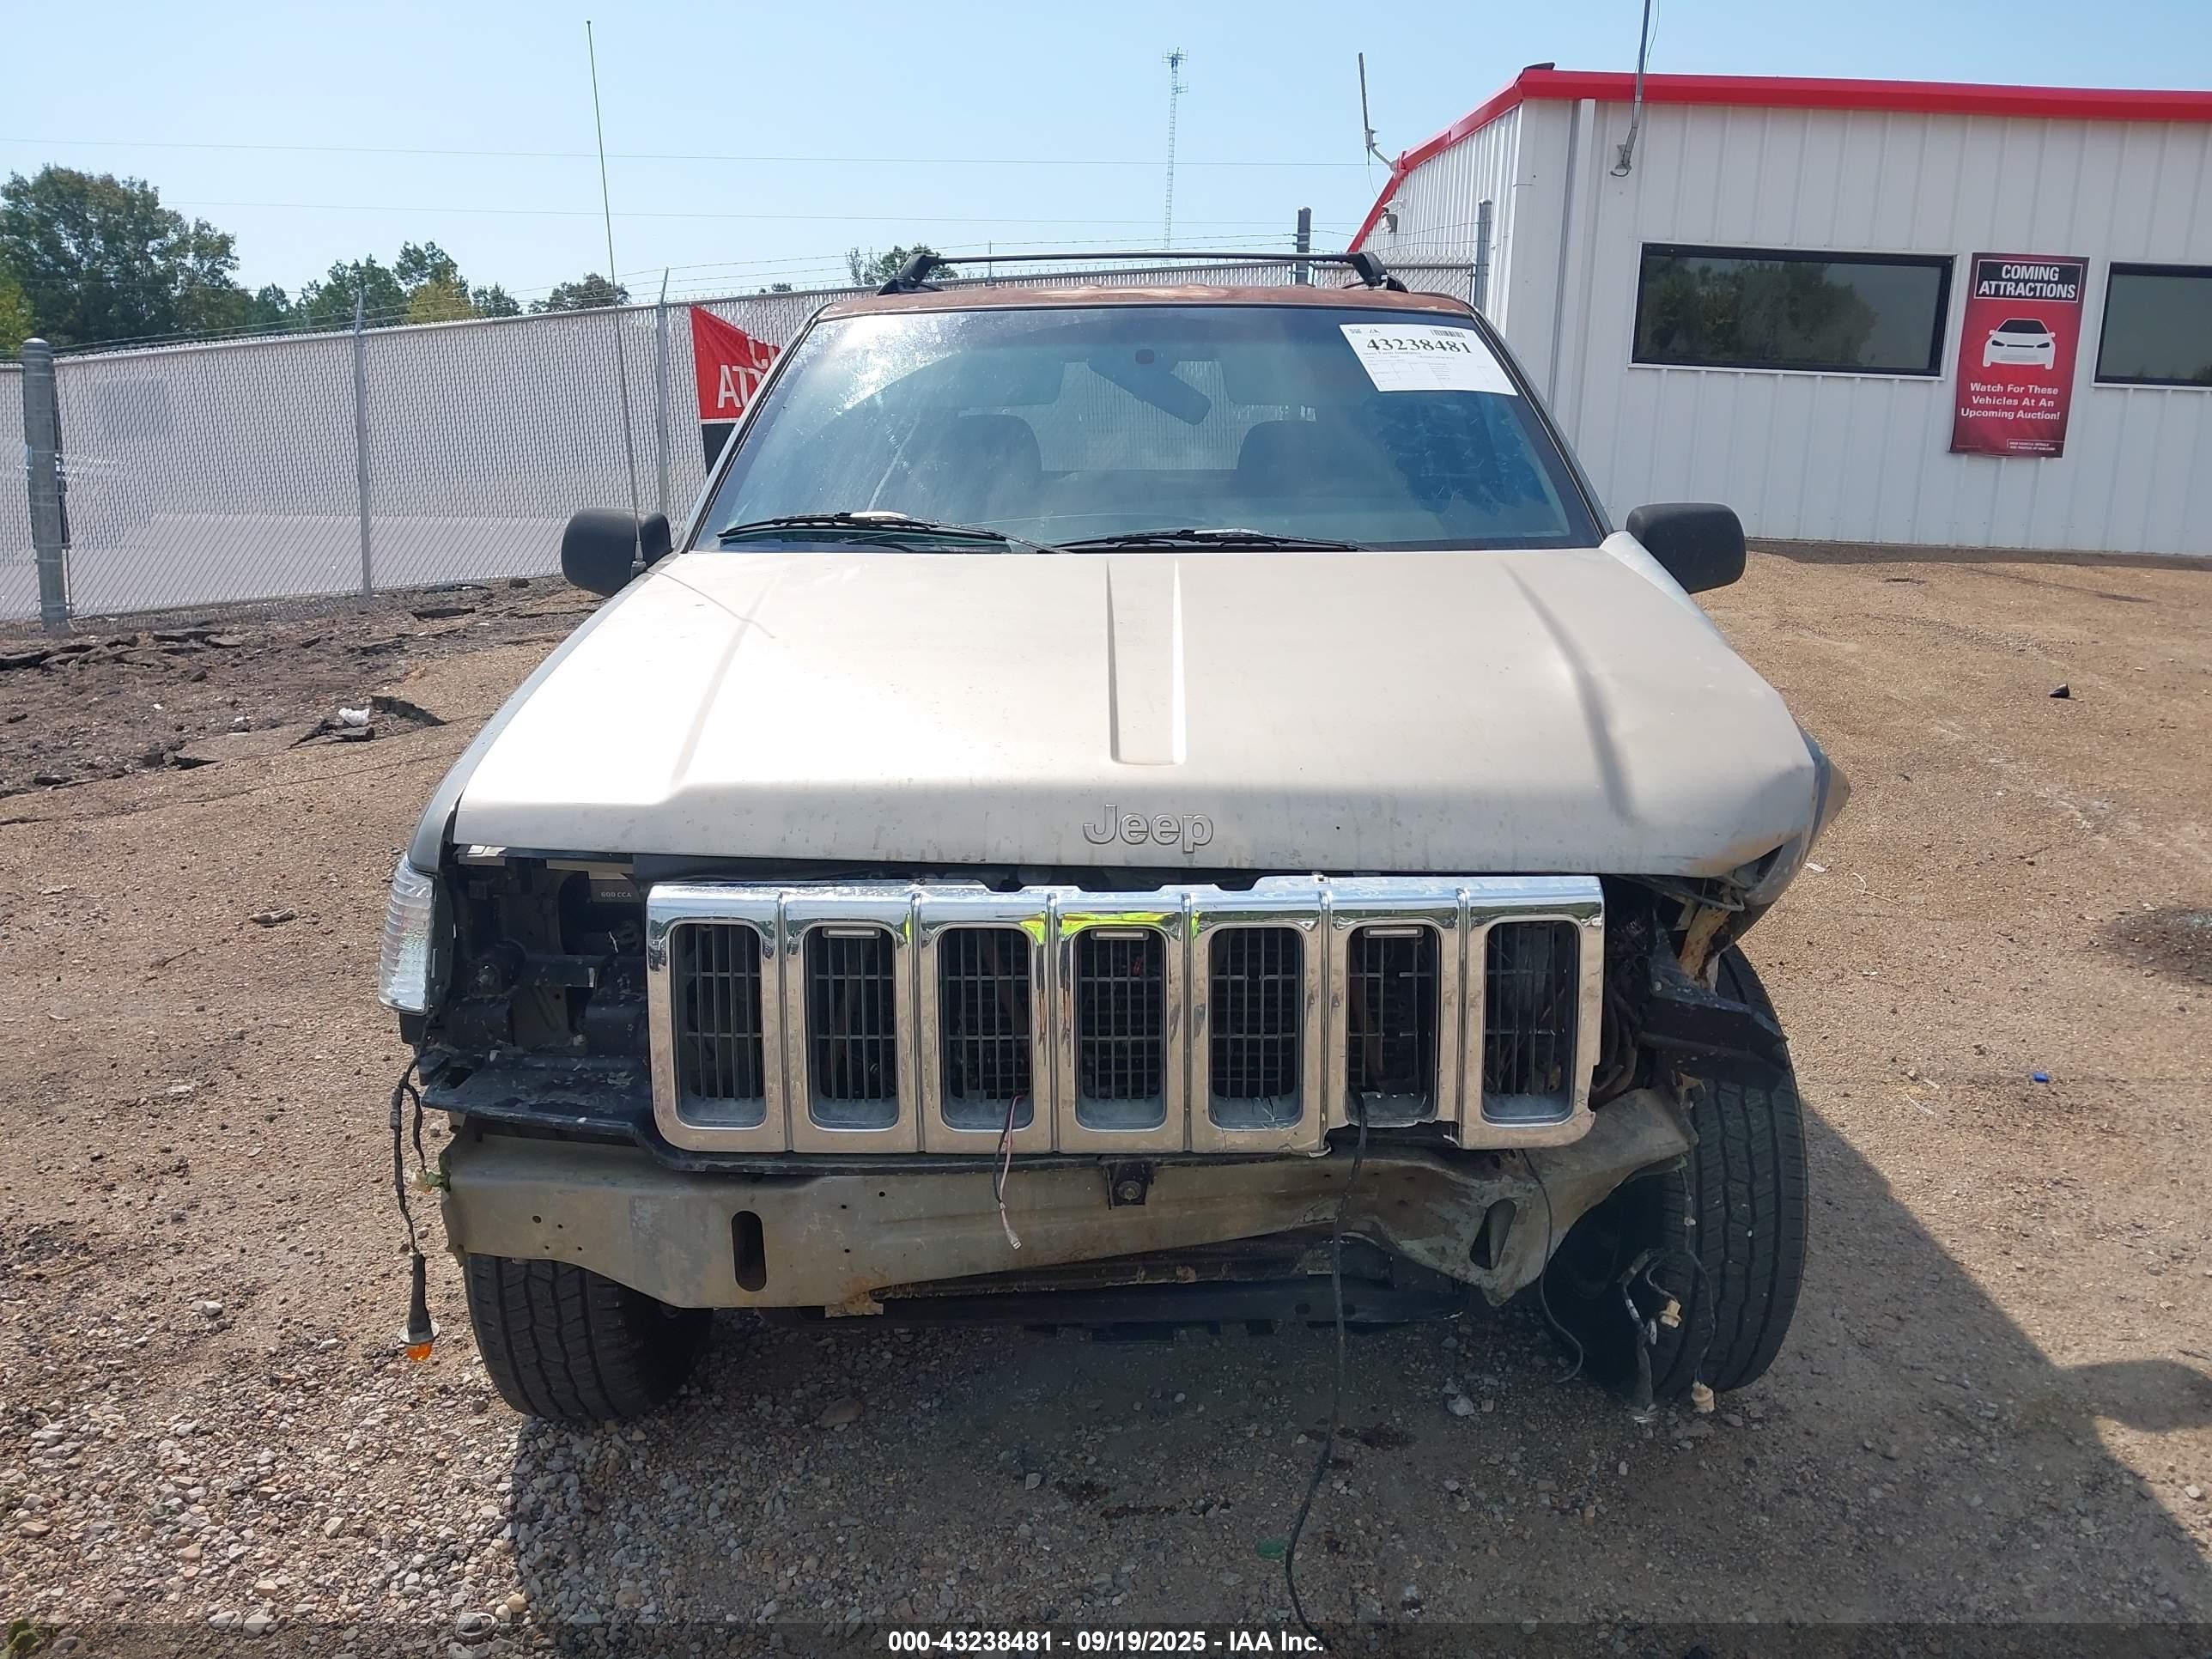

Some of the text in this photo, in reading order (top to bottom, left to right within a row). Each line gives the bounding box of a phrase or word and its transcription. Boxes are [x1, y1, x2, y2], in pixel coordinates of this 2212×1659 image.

[2002, 264, 2059, 281] COMING
[1978, 281, 2076, 299] ATTRACTIONS
[1367, 338, 1472, 353] 43238481
[1970, 382, 2058, 394] Watch For These
[1972, 395, 2054, 407] Vehicles At An
[1960, 408, 2060, 420] Upcoming Auction!
[1083, 804, 1213, 854] Jeep
